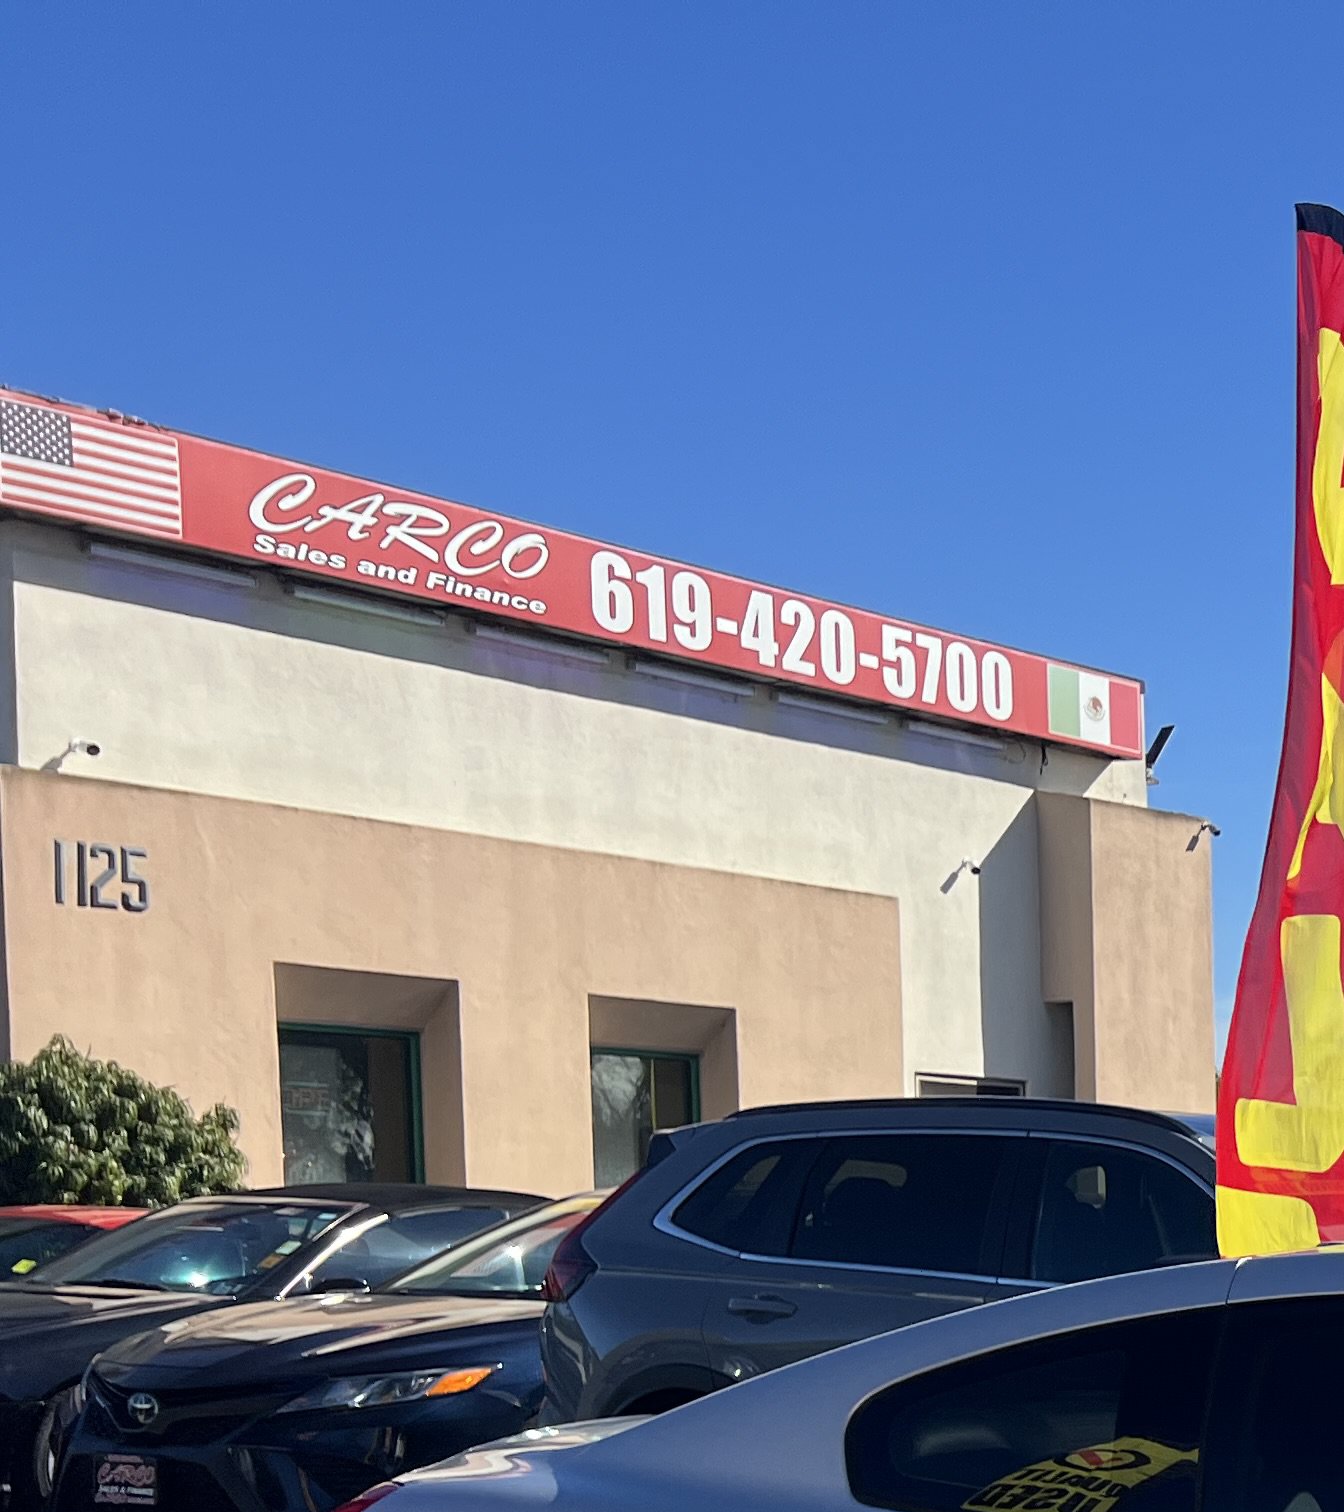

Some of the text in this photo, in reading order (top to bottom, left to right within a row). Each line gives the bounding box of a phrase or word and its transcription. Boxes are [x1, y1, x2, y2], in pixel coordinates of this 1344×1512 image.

[249, 473, 549, 579] CARCO
[254, 534, 548, 614] Sales and Finance
[590, 550, 1015, 722] 619-420-5700
[53, 838, 150, 913] 1125
